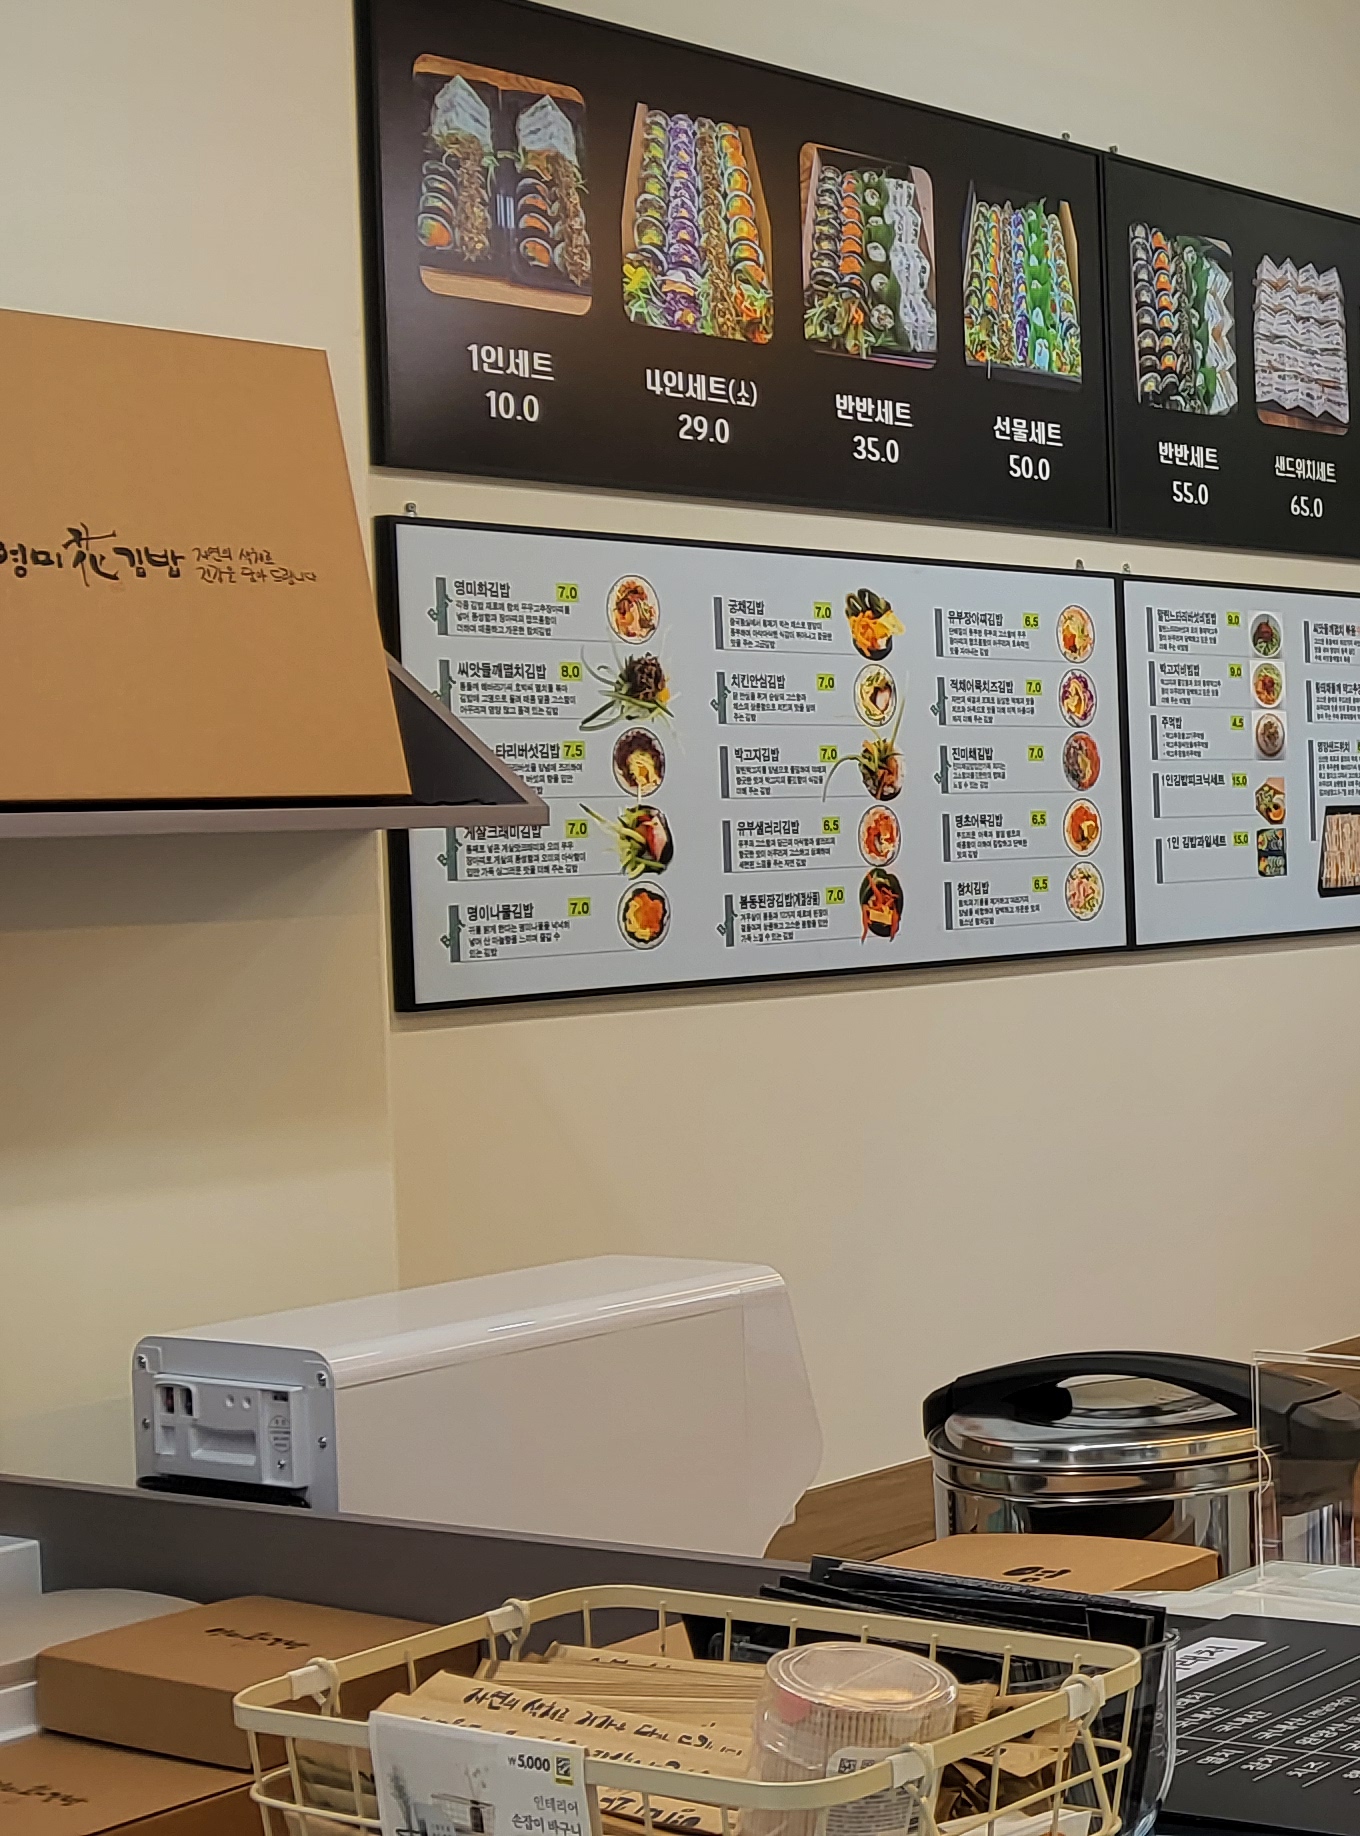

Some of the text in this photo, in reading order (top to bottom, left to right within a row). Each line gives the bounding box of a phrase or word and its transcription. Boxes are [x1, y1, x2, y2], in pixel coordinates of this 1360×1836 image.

[467, 343, 554, 381] 1인세트
[644, 367, 759, 409] 4인세트(소)
[485, 388, 540, 424] 10.0
[835, 391, 914, 429] 반반세트
[677, 414, 730, 445] 29.0
[992, 415, 1065, 449] 선물세트
[852, 435, 900, 465] 35.0
[1158, 440, 1219, 472] 반반세트
[1008, 453, 1051, 482] 50.0
[1274, 455, 1336, 484] 샌드위치세트
[1172, 480, 1209, 506] 55.0
[1290, 496, 1323, 519] 65.0
[453, 580, 578, 599] 영미화김밥 7.0
[815, 606, 831, 618] 7.0
[1227, 615, 1240, 625] 9.0
[1025, 616, 1039, 627] 6.5
[457, 662, 581, 680] 씨앗들깨멸치김밥 8.0
[1230, 666, 1242, 677] 9.0
[731, 674, 834, 689] 치킨안심김밥 7.0
[1027, 682, 1041, 693] 7.0
[1161, 717, 1182, 729] 주먹밥
[564, 745, 582, 757] 7.5
[734, 748, 837, 762] 박고지김밥 7.0
[1029, 748, 1043, 759] 7.0
[568, 823, 587, 834] 7.0
[823, 820, 839, 832] 6.5
[1032, 814, 1046, 825] 6.5
[1167, 837, 1179, 849] 1인
[828, 890, 844, 901] 7.0
[957, 879, 1048, 895] 참치김밥 6.5
[467, 903, 589, 921] 명이나물김밥 7.0
[1176, 1645, 1239, 1671] 래처
[1212, 1711, 1272, 1732] 국내산
[1197, 1749, 1244, 1764] 멸치
[1253, 1718, 1312, 1739] 국내산
[1241, 1724, 1354, 1770] 참치 원양산
[1287, 1762, 1330, 1777] 치즈
[533, 1796, 579, 1817] 인테리어
[511, 1813, 545, 1833] 손잡이
